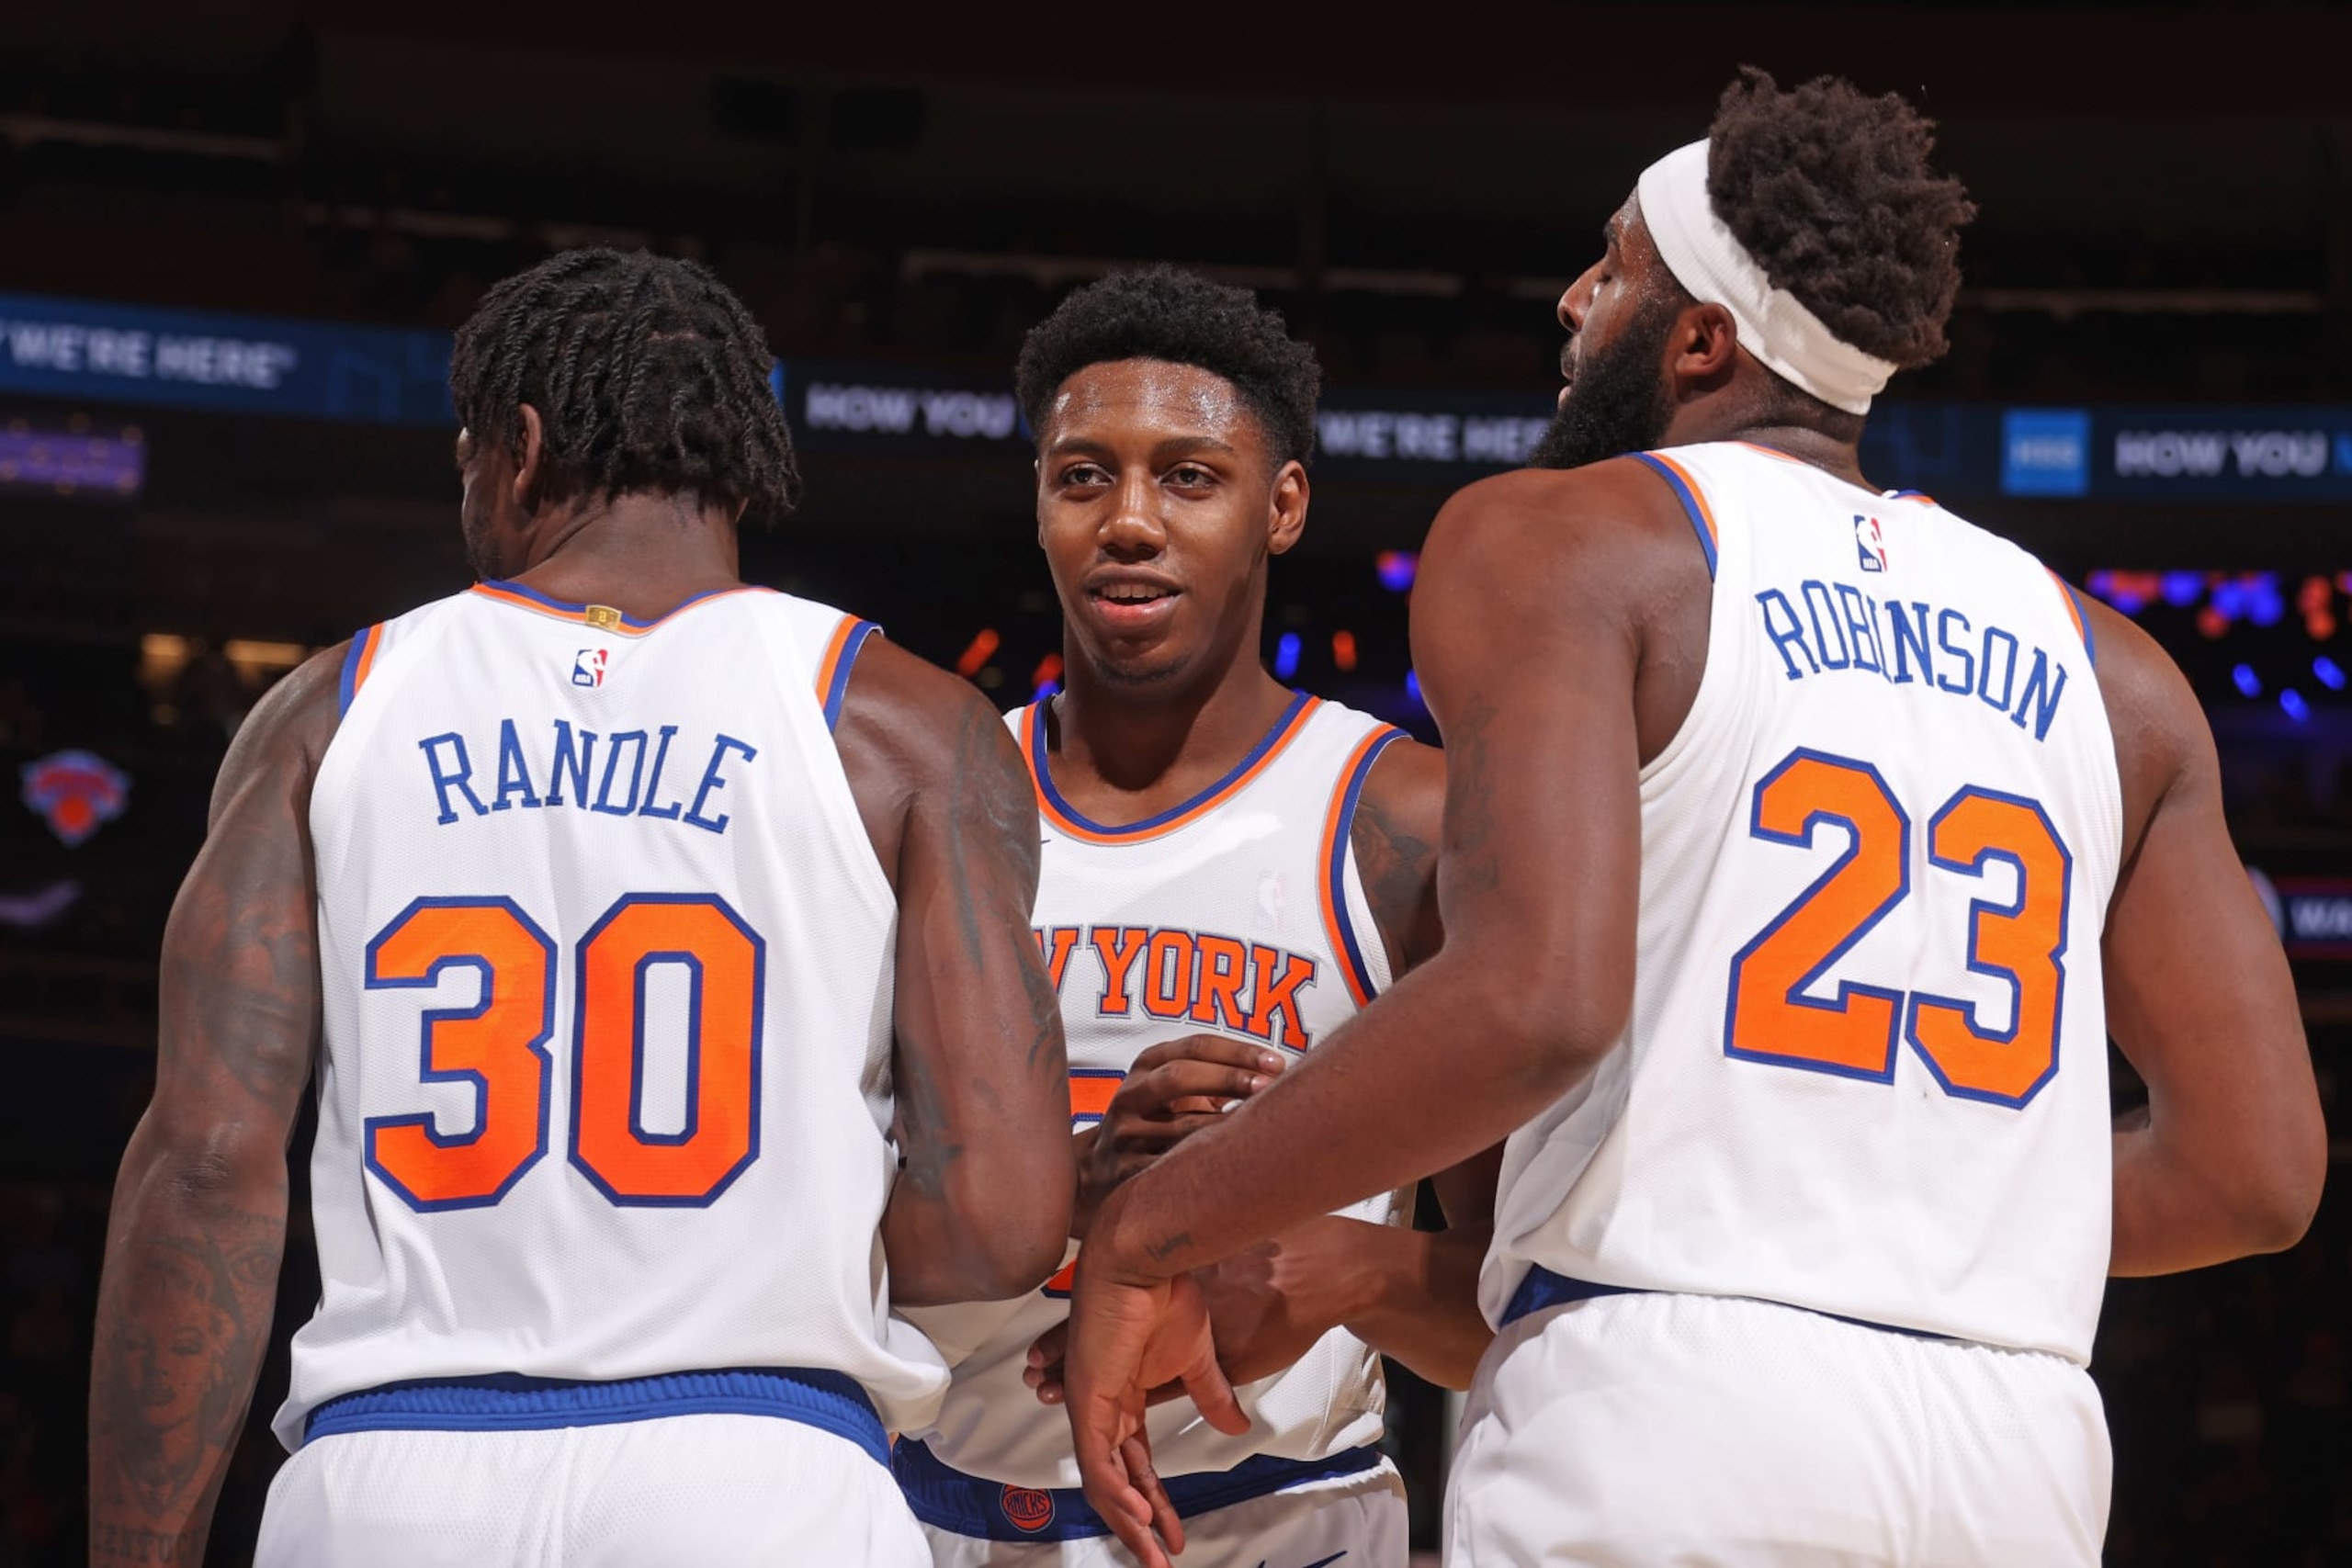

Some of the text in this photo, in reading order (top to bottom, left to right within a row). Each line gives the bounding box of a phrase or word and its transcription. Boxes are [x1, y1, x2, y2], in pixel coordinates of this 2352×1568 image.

[806, 383, 1015, 439] HOW YOU
[2115, 430, 2227, 478] HOW
[2231, 430, 2329, 478] YOU
[1755, 580, 2067, 742] ROBINSON
[419, 718, 757, 834] RANDLE
[1724, 746, 2073, 1111] 23
[1089, 926, 1319, 1054] YORK
[365, 892, 766, 1213] 30
[1005, 1491, 1047, 1517] KNICKS
